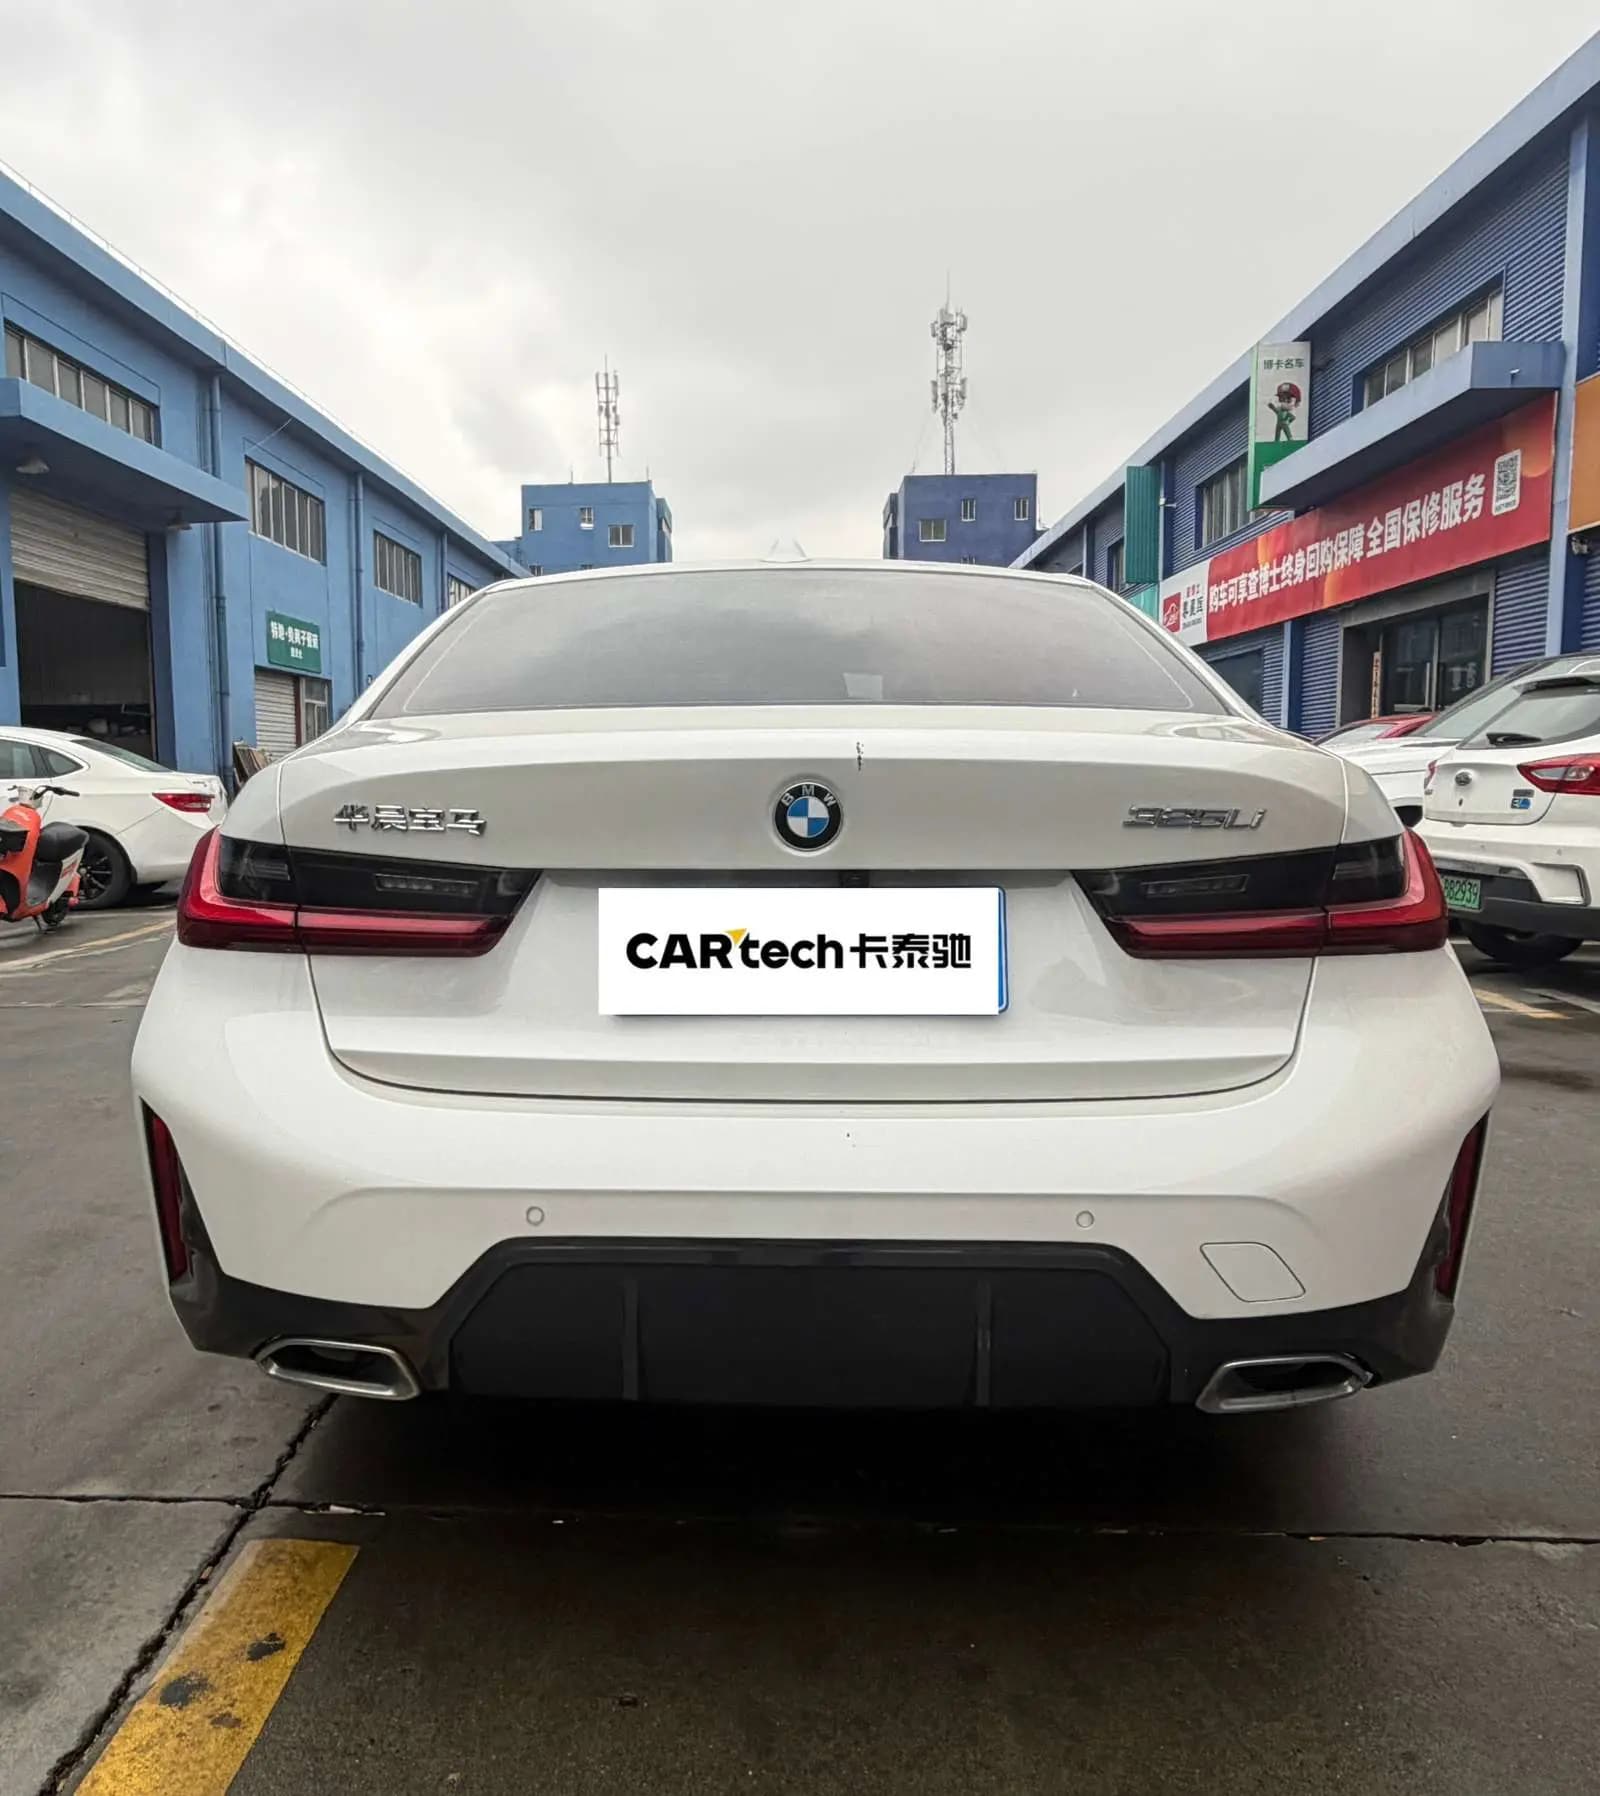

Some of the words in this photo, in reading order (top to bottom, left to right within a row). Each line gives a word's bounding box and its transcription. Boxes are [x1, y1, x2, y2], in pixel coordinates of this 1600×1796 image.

[781, 783, 837, 807] BMW
[333, 804, 487, 836] 华晨宝马
